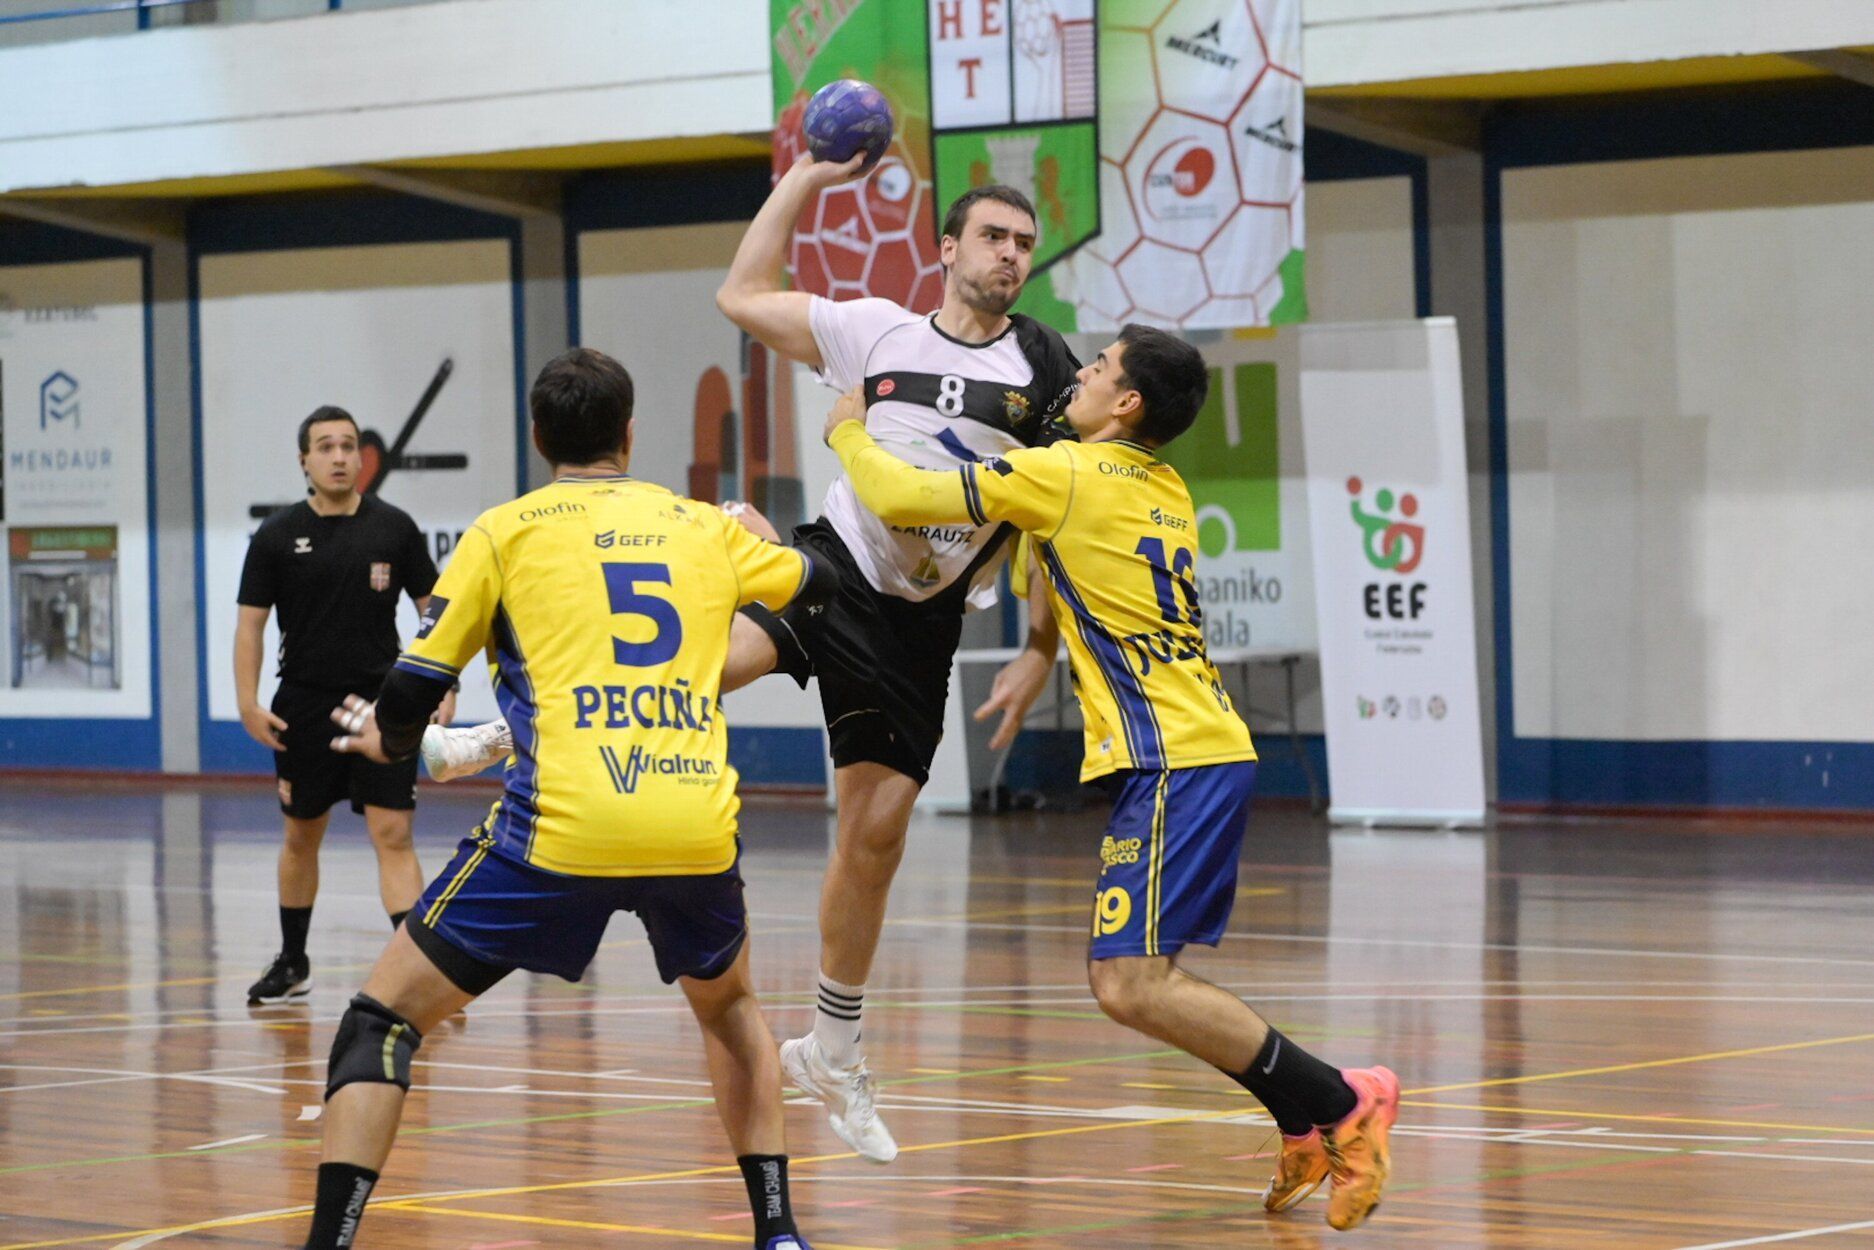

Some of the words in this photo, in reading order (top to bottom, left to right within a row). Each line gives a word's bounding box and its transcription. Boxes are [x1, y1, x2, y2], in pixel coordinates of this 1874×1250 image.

[936, 374, 966, 418] 8
[10, 447, 113, 472] MENDAUR
[1098, 461, 1149, 483] Olofin
[519, 501, 587, 523] Olofin
[1163, 514, 1189, 533] GEFF
[619, 534, 668, 548] GEFF
[1363, 582, 1428, 620] EEF
[600, 562, 683, 668] 5
